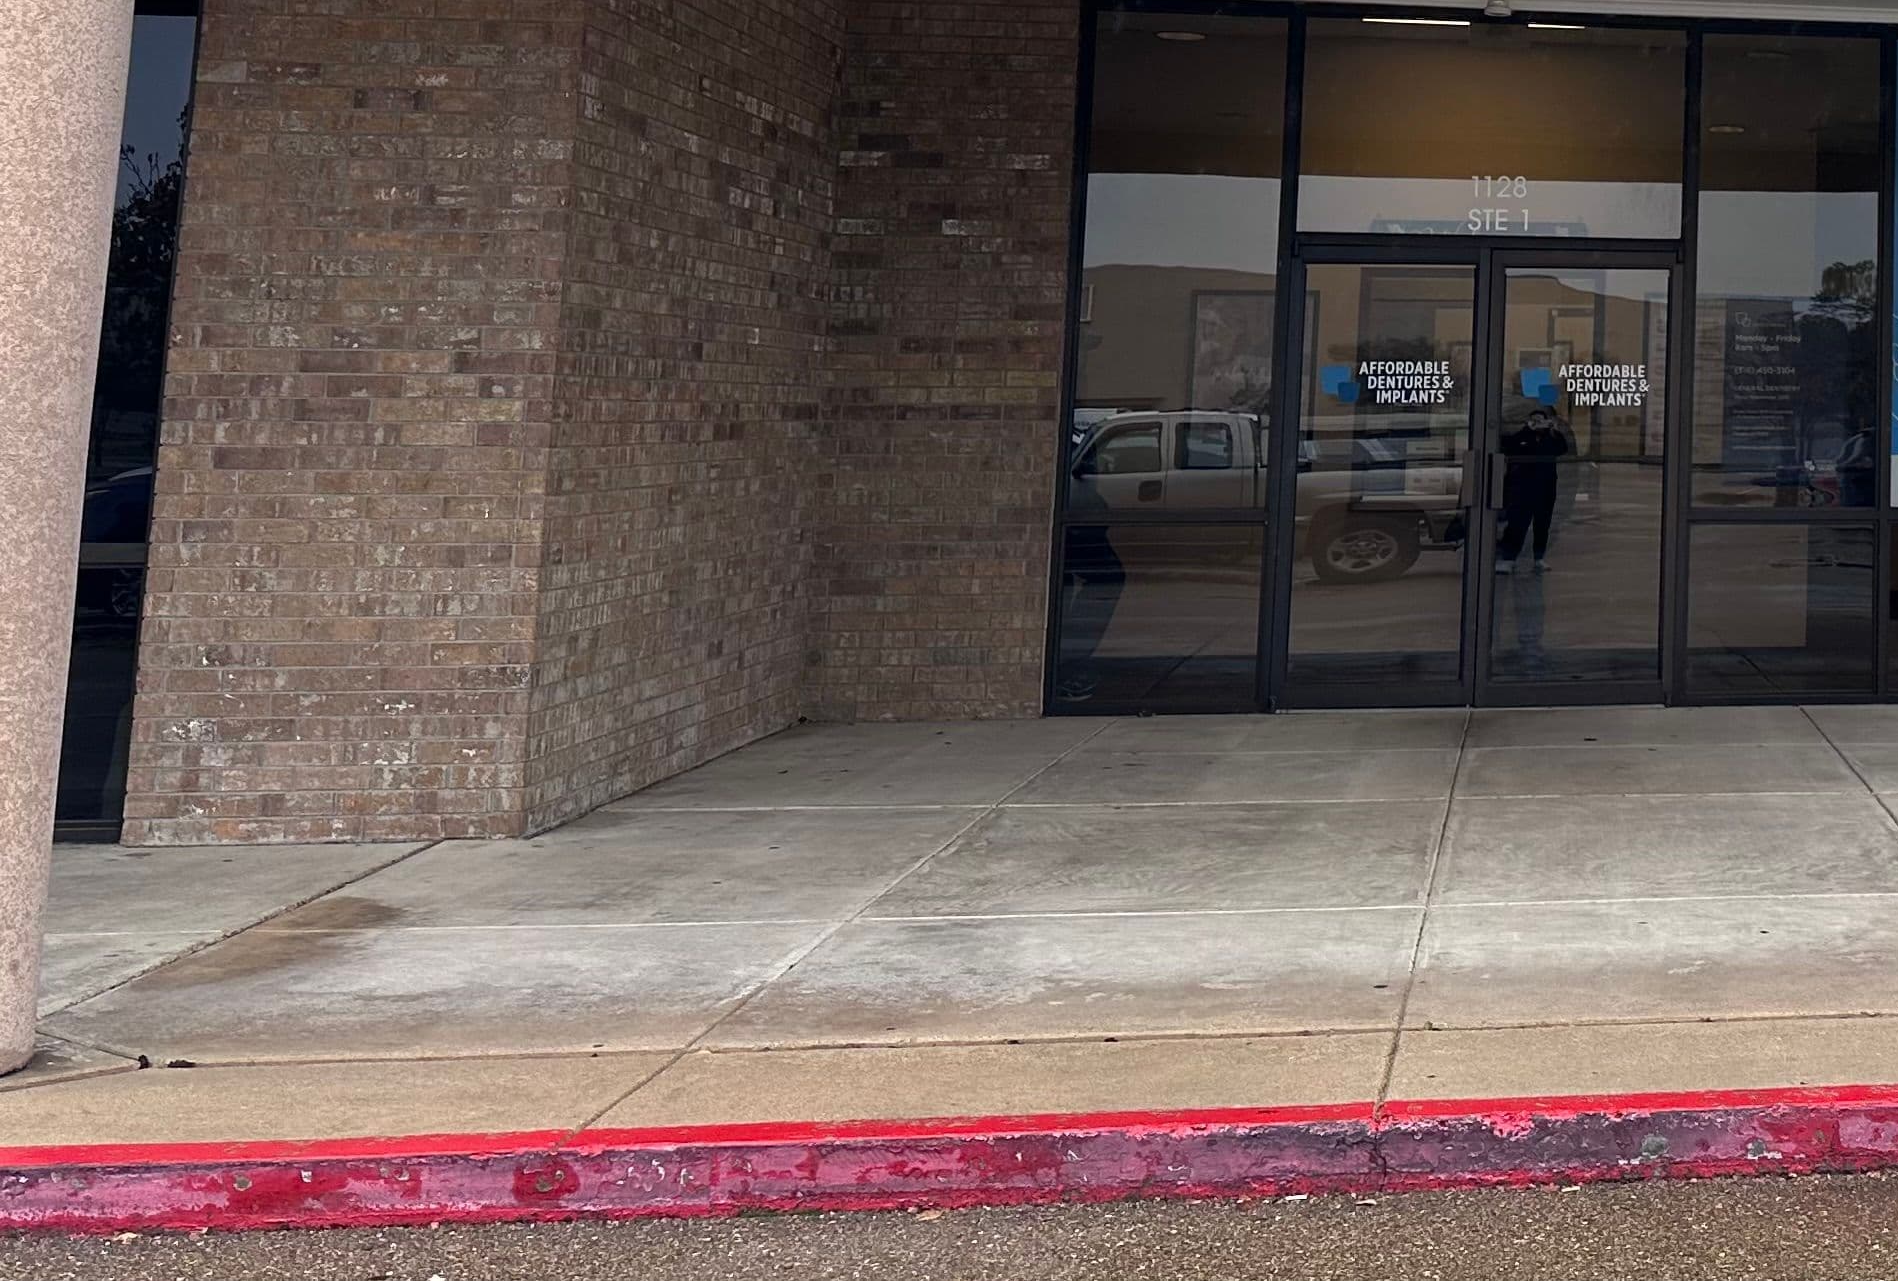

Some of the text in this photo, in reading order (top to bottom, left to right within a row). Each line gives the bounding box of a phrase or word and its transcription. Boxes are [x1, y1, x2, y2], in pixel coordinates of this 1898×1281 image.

[1471, 175, 1528, 199] 1128
[1467, 209, 1530, 232] STE 1
[1358, 361, 1450, 375] AFFORDABLE
[1558, 364, 1646, 378] AFFORDABLE
[1367, 375, 1455, 389] DENTURES &
[1566, 378, 1650, 392] DENTURES &
